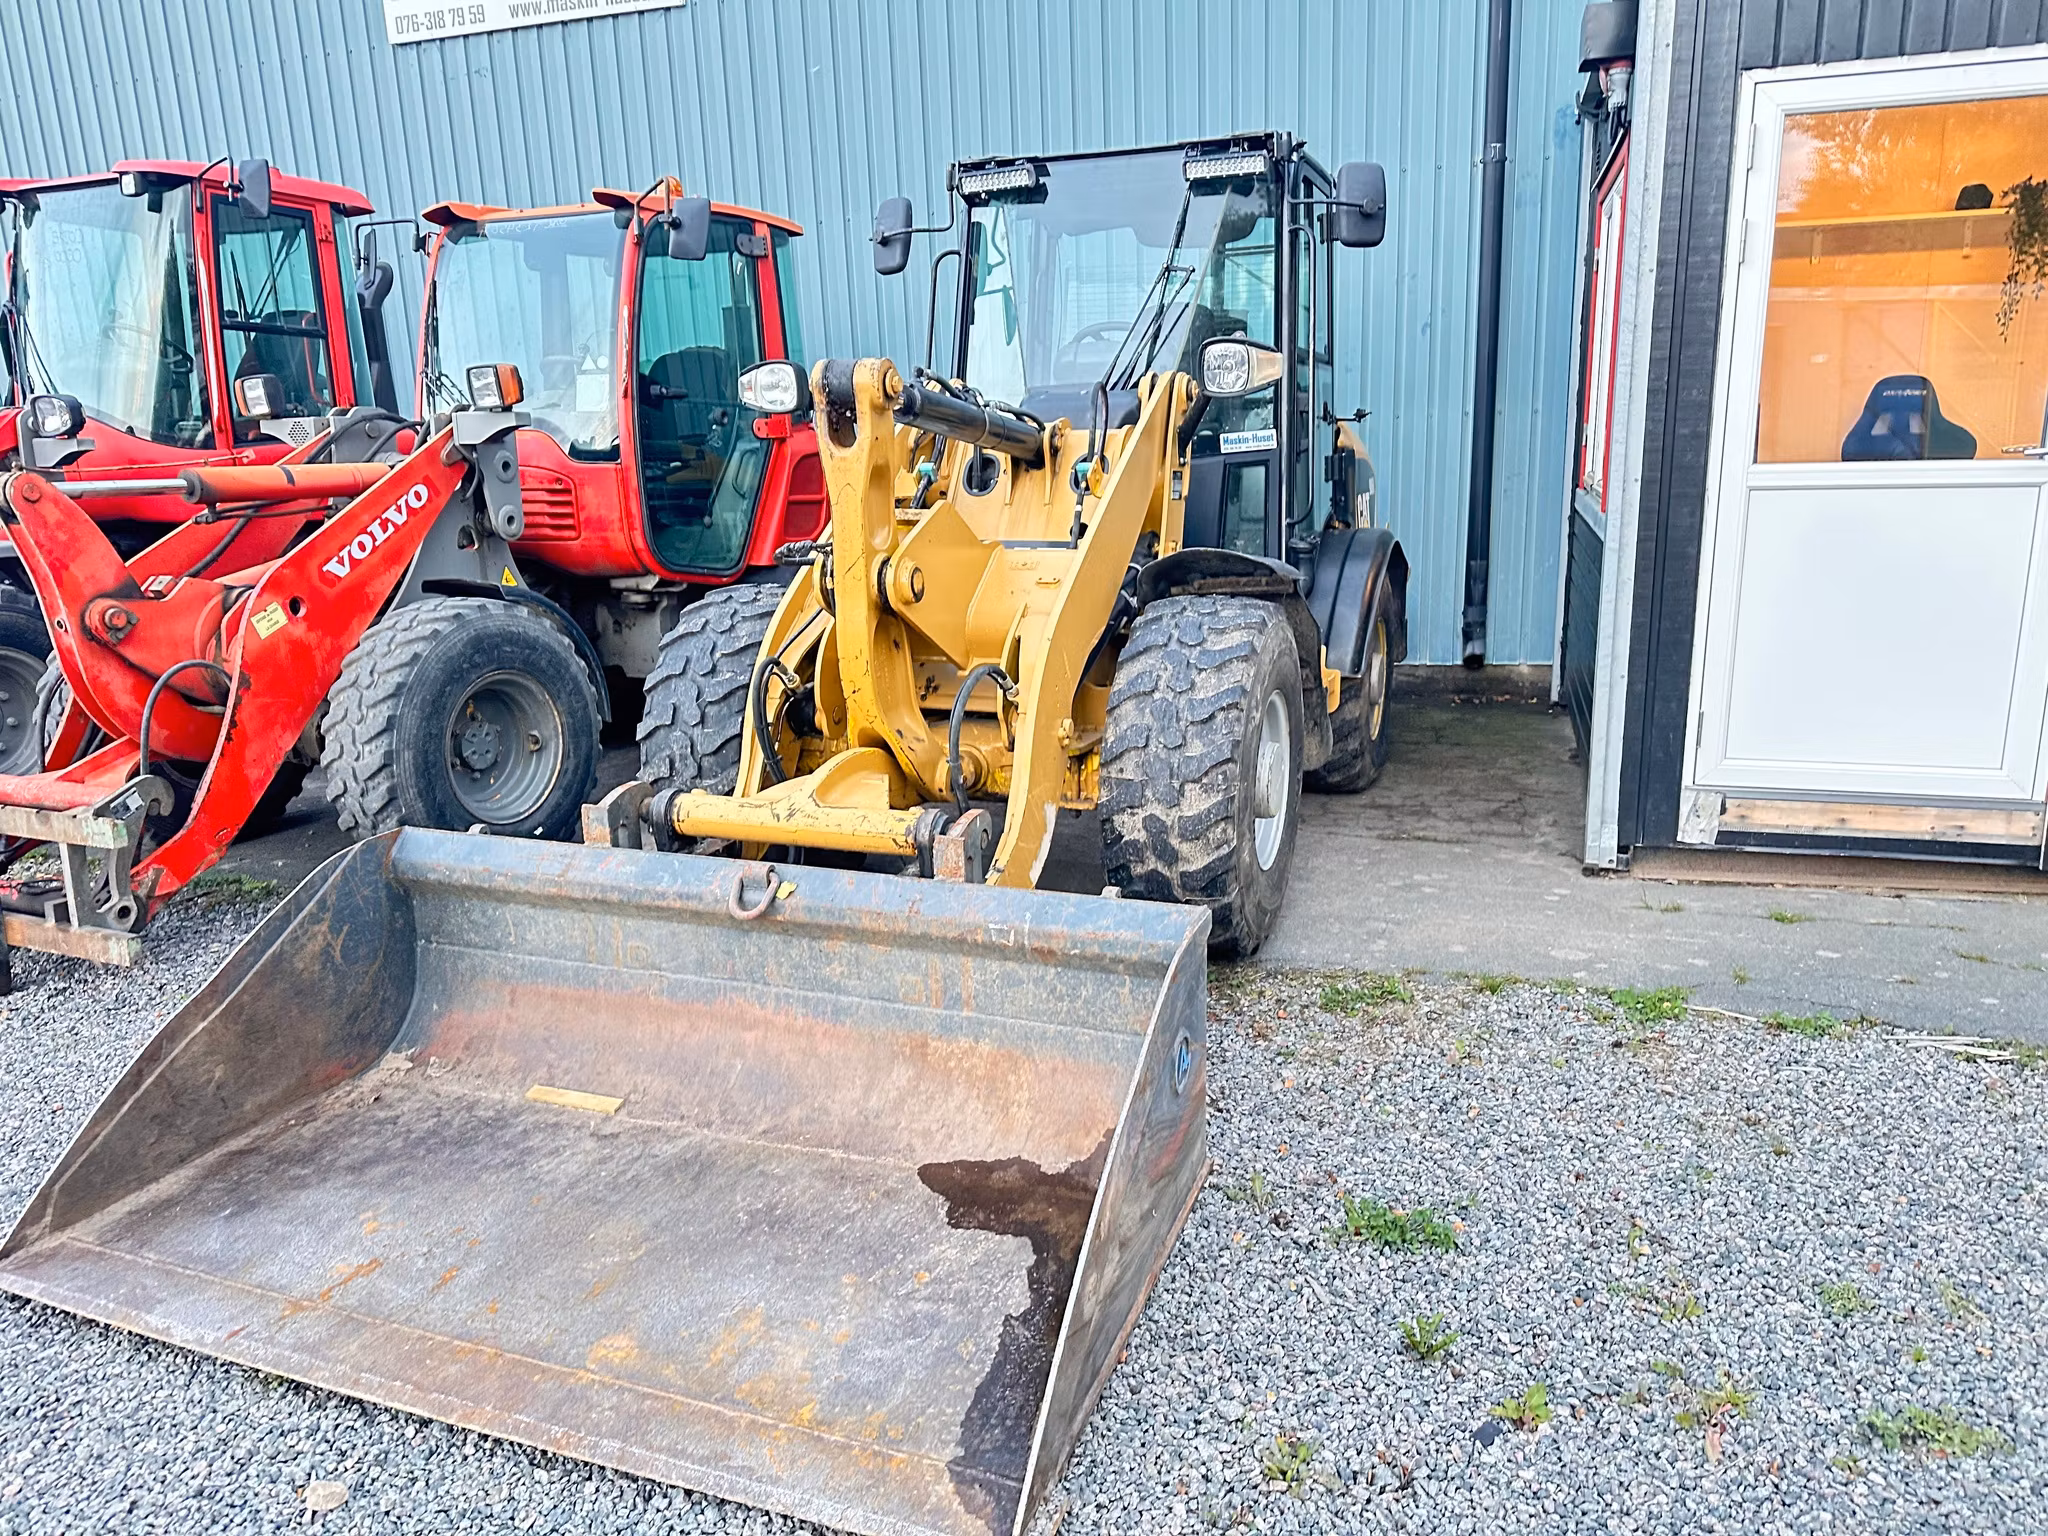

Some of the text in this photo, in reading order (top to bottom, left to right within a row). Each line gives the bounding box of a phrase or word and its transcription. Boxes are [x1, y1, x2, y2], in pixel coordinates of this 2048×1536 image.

[395, 10, 446, 34] 076-318
[448, 7, 466, 27] 79
[468, 4, 486, 24] 59
[1223, 433, 1274, 446] Maskin-Huset
[1357, 492, 1371, 528] CAT
[322, 484, 429, 578] VOLVO
